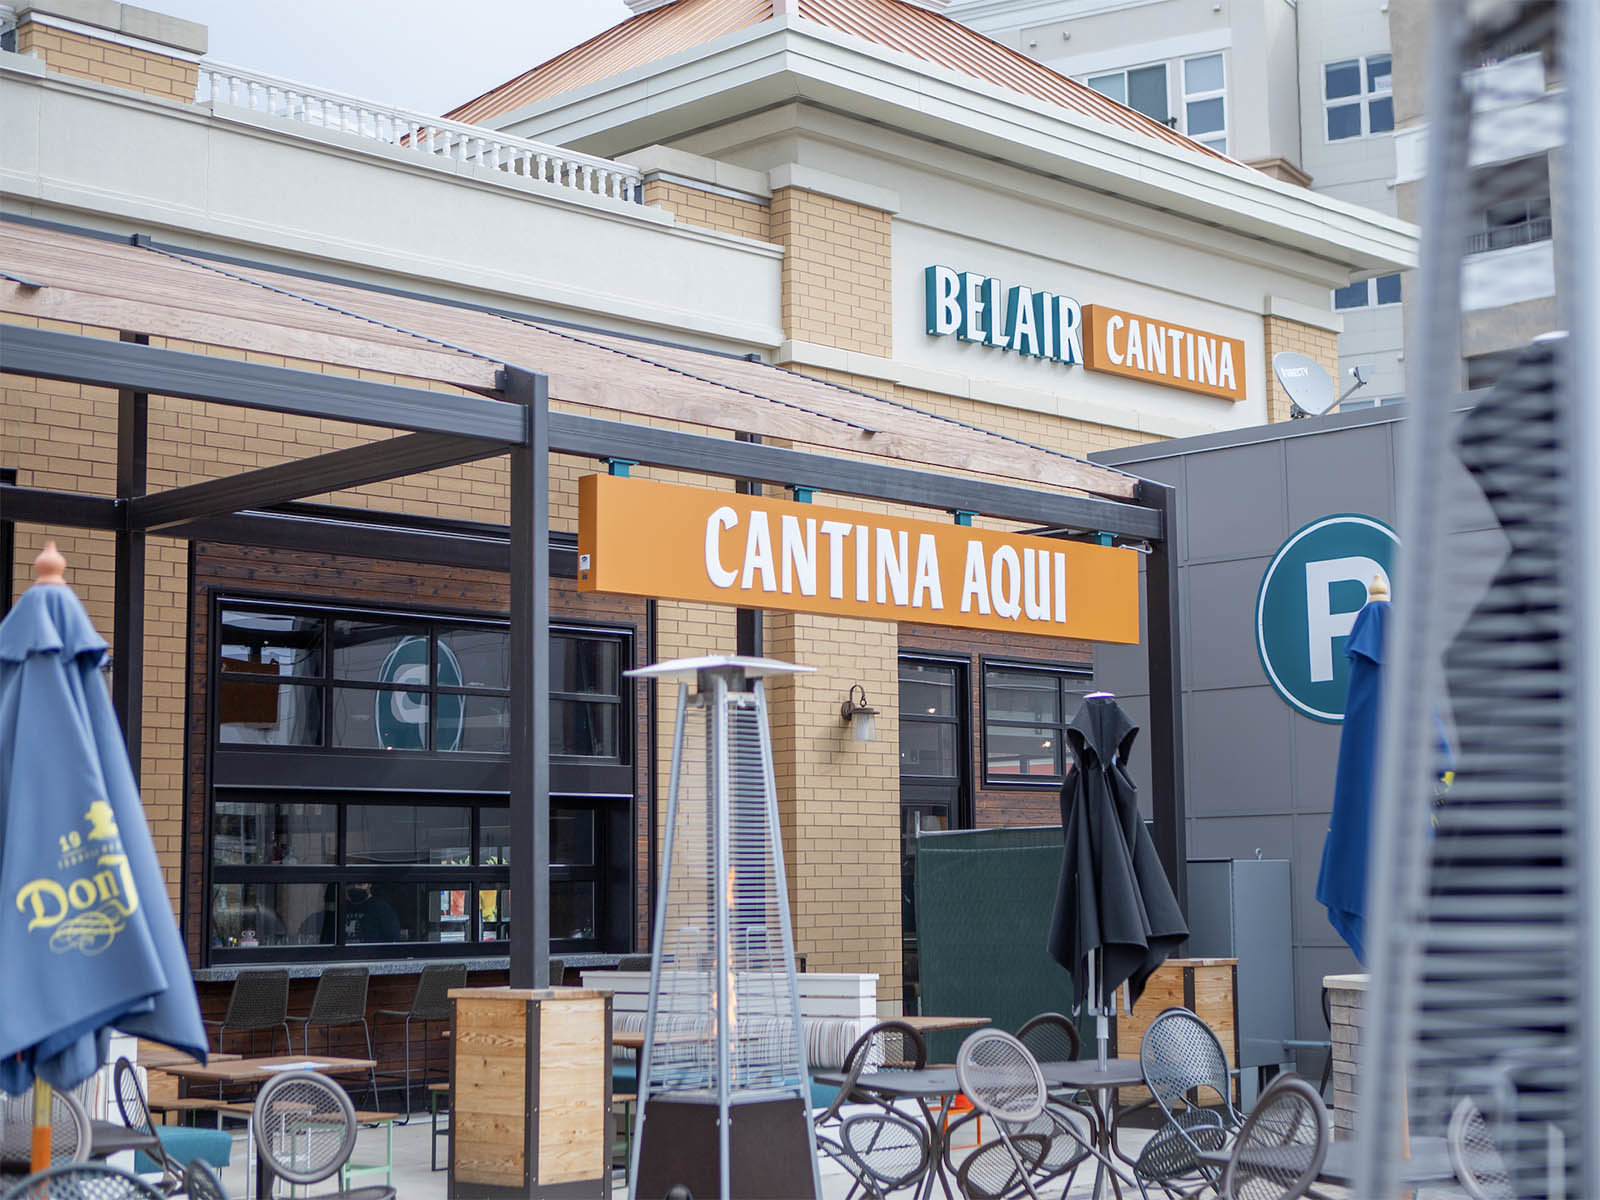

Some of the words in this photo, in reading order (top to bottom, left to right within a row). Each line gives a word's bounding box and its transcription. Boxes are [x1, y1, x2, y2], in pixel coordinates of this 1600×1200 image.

[926, 265, 1083, 366] BELAIR
[1106, 315, 1237, 391] CANTINA
[705, 506, 944, 610] CANTINA
[961, 540, 1067, 624] AQUI
[1305, 556, 1391, 682] P
[16, 869, 120, 933] Don
